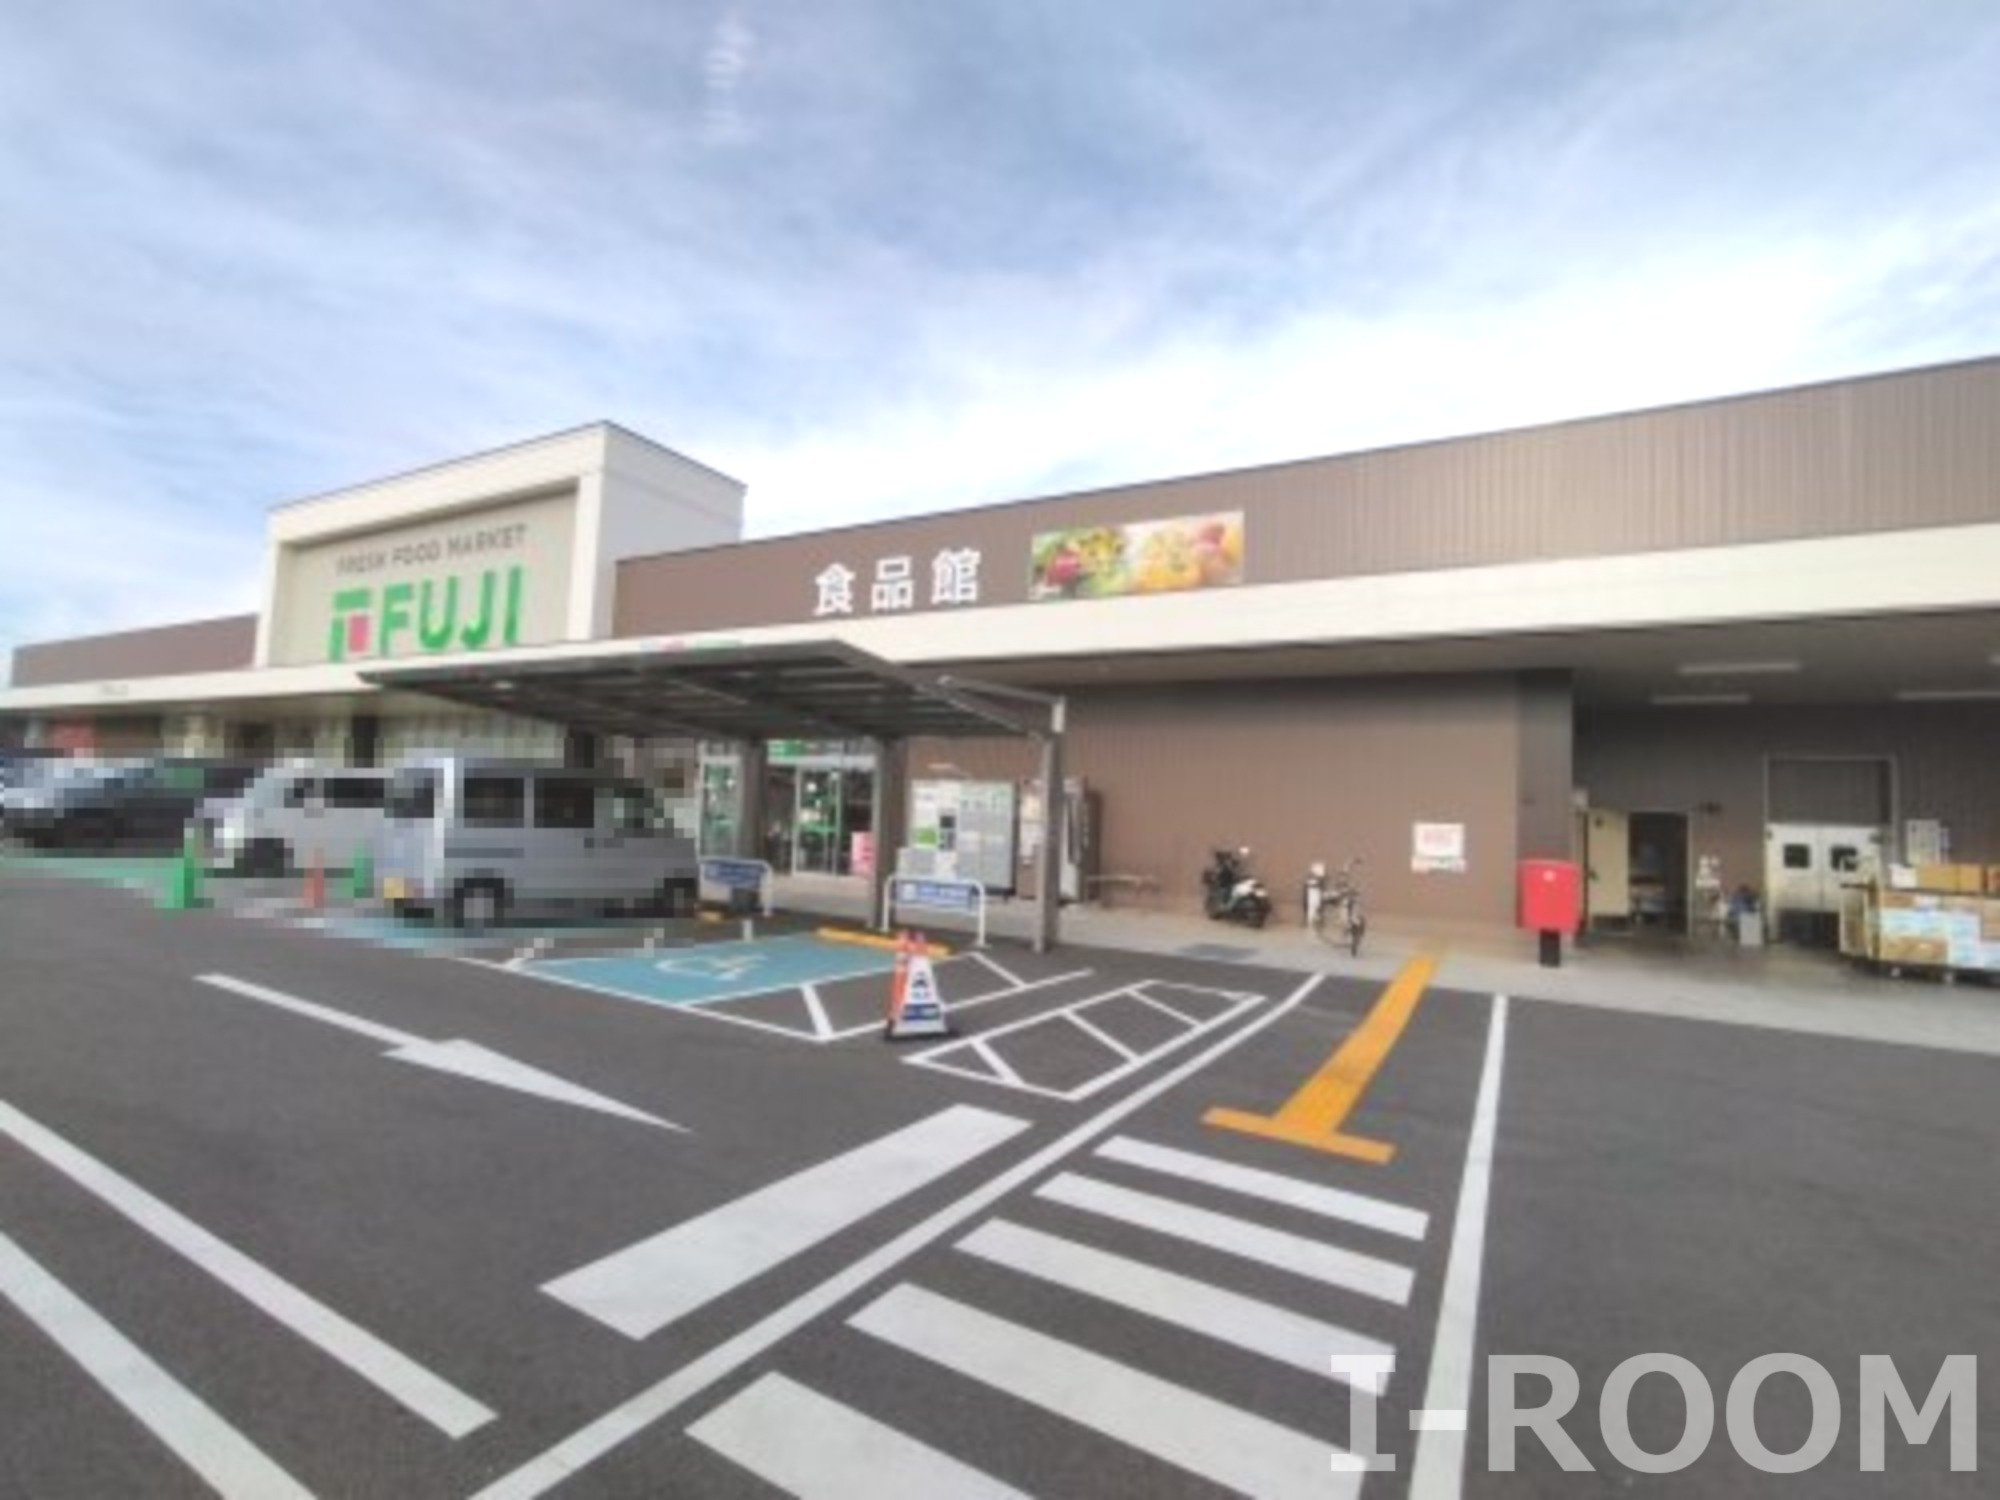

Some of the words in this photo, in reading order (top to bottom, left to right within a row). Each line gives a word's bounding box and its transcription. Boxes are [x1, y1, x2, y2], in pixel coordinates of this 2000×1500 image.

[392, 540, 440, 565] FOOD
[448, 523, 527, 556] MARKET
[379, 566, 522, 658] FUJI
[814, 547, 982, 616] 食品館
